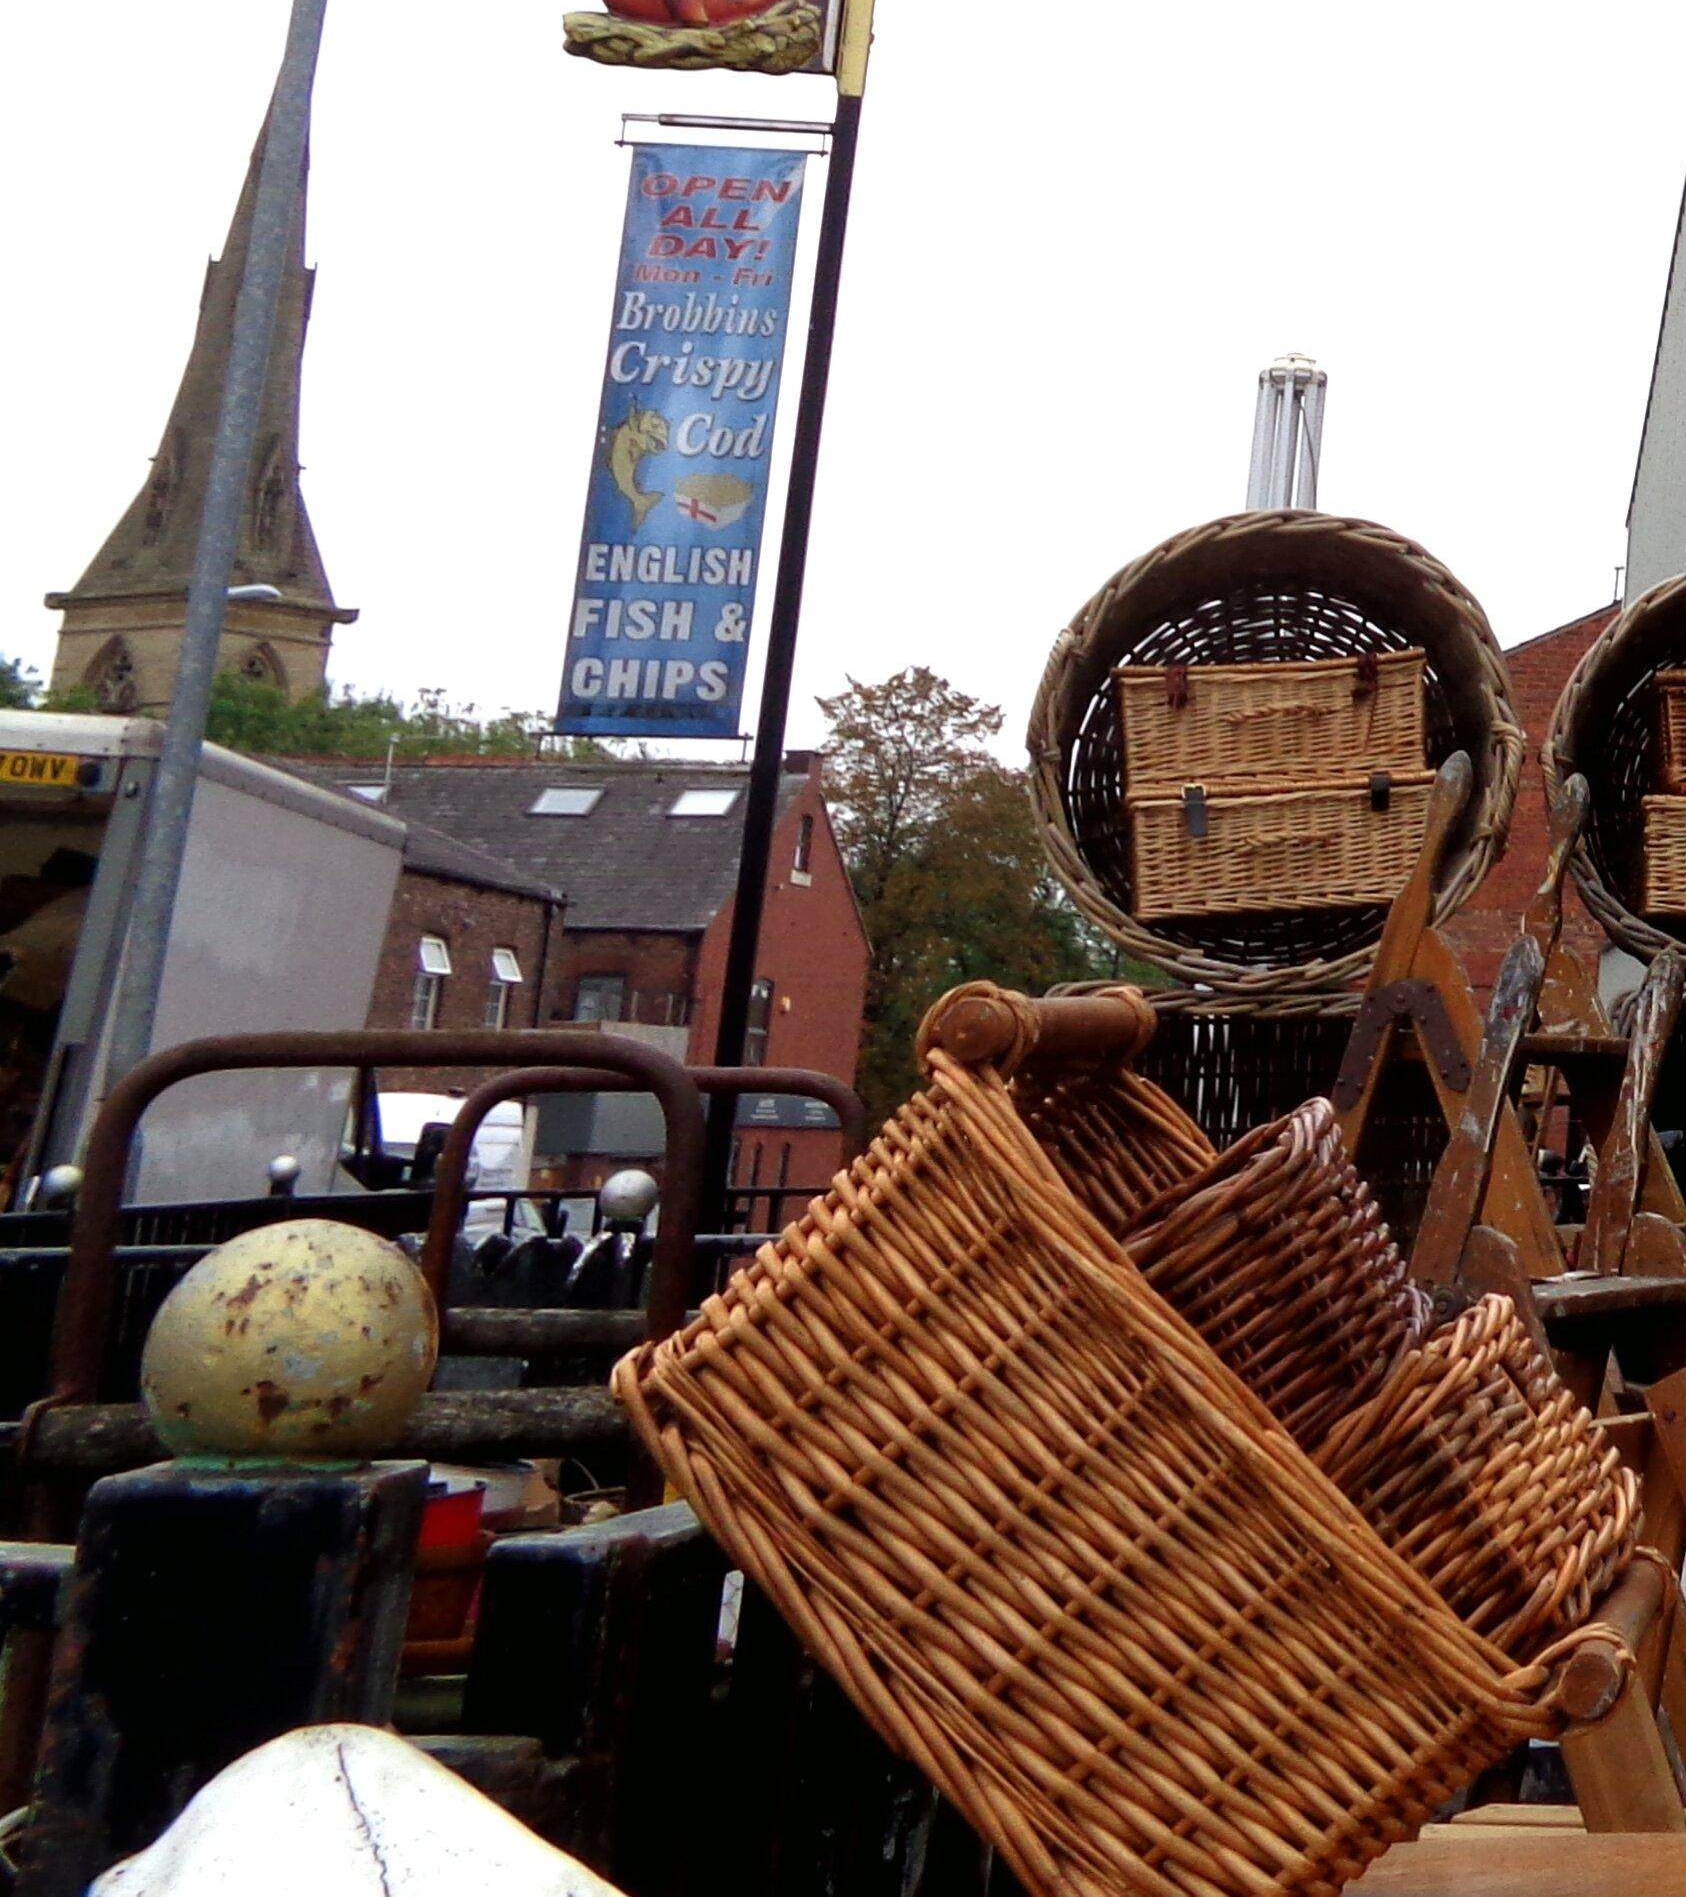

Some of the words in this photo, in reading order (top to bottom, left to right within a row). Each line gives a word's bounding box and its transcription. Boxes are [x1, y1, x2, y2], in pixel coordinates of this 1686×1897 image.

[641, 173, 792, 204] OPEN
[661, 204, 761, 232] ALL
[648, 234, 770, 261] DAY!
[634, 264, 702, 286] Mon
[733, 267, 773, 288] Fri
[616, 291, 776, 337] Brobbins
[609, 342, 774, 401] Crispy
[676, 412, 768, 460] Cod
[586, 543, 754, 586] ENGLISH
[574, 598, 695, 642] FISH
[714, 601, 746, 643] &
[571, 656, 729, 702] CHIPS
